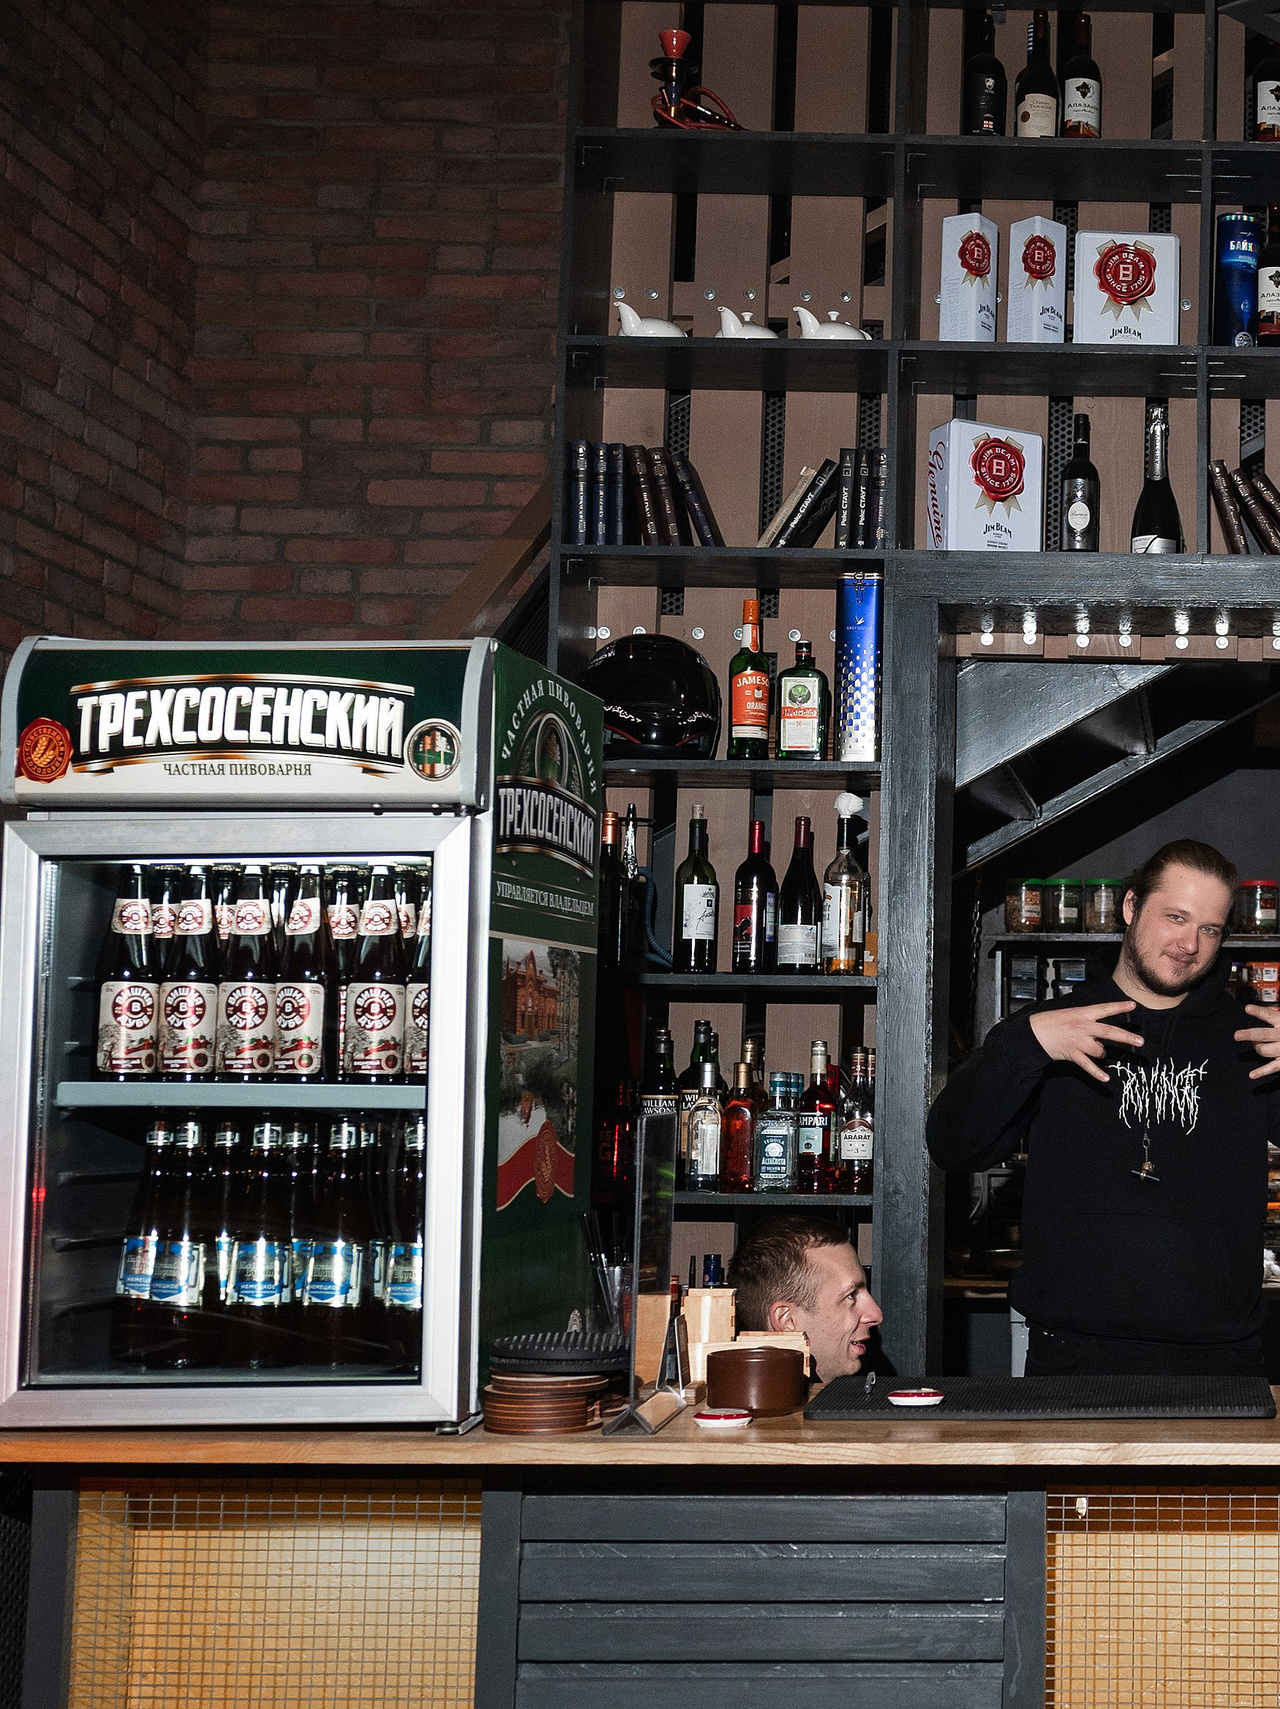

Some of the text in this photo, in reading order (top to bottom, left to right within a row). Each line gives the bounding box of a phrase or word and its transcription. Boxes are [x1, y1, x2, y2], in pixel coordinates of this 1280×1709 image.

[1108, 252, 1145, 269] JIM BEAM
[1119, 264, 1133, 281] B
[1105, 273, 1146, 292] SINCE 1795
[1040, 305, 1050, 316] JIM
[1110, 325, 1142, 340] JIM BEAM
[982, 447, 1016, 470] JIM BEAM
[992, 458, 1006, 477] B
[980, 467, 1017, 488] SINCE 1795
[799, 491, 815, 514] СТАУТ
[841, 486, 849, 509] СТАУТ
[859, 485, 867, 508] СТАУТ
[982, 522, 1013, 539] JIM BEAM
[746, 701, 768, 711] ORANGE
[76, 686, 405, 758] ТРЕХСОСЕНСКИЙ
[501, 679, 597, 794] ЧАСТНАЯ ПИВОВАРНЯ
[163, 762, 312, 776] ЧАСТНАЯ ПИВОВАРНЯ
[498, 787, 595, 867] ТРЕХСОСЕНСКИЙ
[496, 880, 595, 917] УПРАВЛЯЕТСЯ ВЛАДЕЛЬЦЕМ
[114, 986, 153, 1004] ВИШНЯ
[165, 986, 205, 1005] ВИШНЯ
[227, 986, 267, 1005] ВИШНЯ
[355, 987, 394, 1006] ВИШНЯ
[116, 1014, 150, 1029] ДУБЕ
[228, 1014, 263, 1029] ДУБЕ
[358, 1015, 391, 1030] ДУБЕ
[642, 1099, 676, 1108] WILLIAM
